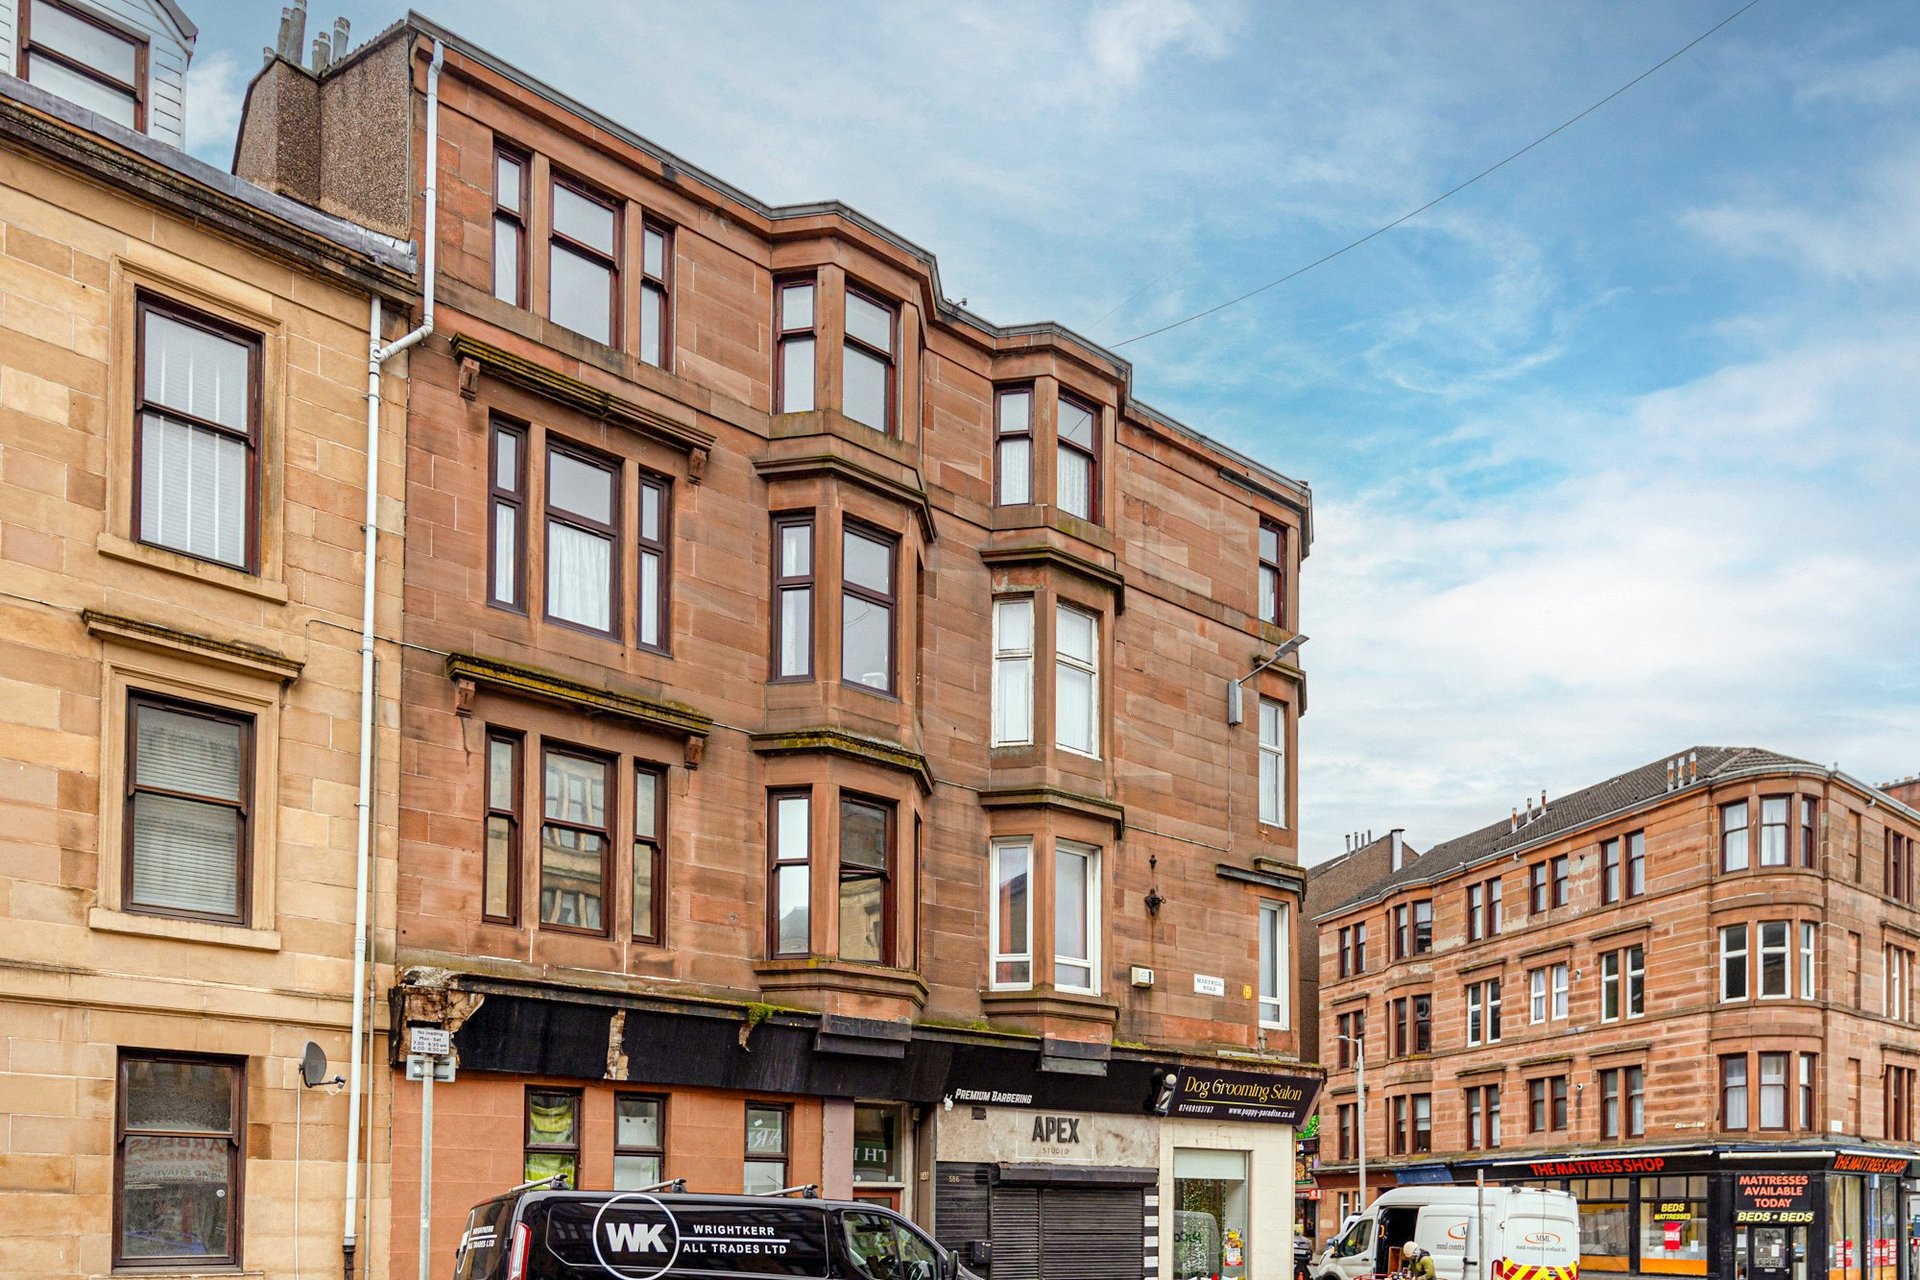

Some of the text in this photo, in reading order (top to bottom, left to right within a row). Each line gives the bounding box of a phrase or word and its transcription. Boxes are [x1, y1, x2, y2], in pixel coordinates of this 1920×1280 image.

[1196, 977, 1222, 986] MARYHILL
[1184, 1075, 1302, 1103] Dog Grooming Salon
[955, 1088, 1033, 1104] PREMIUM BARBERING
[1032, 1115, 1080, 1144] APEX
[1043, 1147, 1069, 1155] STUDIO
[1530, 1157, 1665, 1176] THE MATTRESS SHOP
[1833, 1155, 1907, 1174] THE MATTRESS SHOP
[1739, 1175, 1809, 1186] MATTRESSES
[1744, 1187, 1803, 1197] AVAILABLE
[1661, 1203, 1685, 1213] BEDS
[1754, 1198, 1792, 1209] TODAY
[1654, 1213, 1691, 1221] MATTRESSES
[1737, 1211, 1814, 1223] BEDS BEDS
[693, 1224, 775, 1236] WRIGHTKERR
[605, 1223, 668, 1253] WK
[1535, 1234, 1552, 1243] MML
[683, 1243, 787, 1255] ALL TRADES LTD
